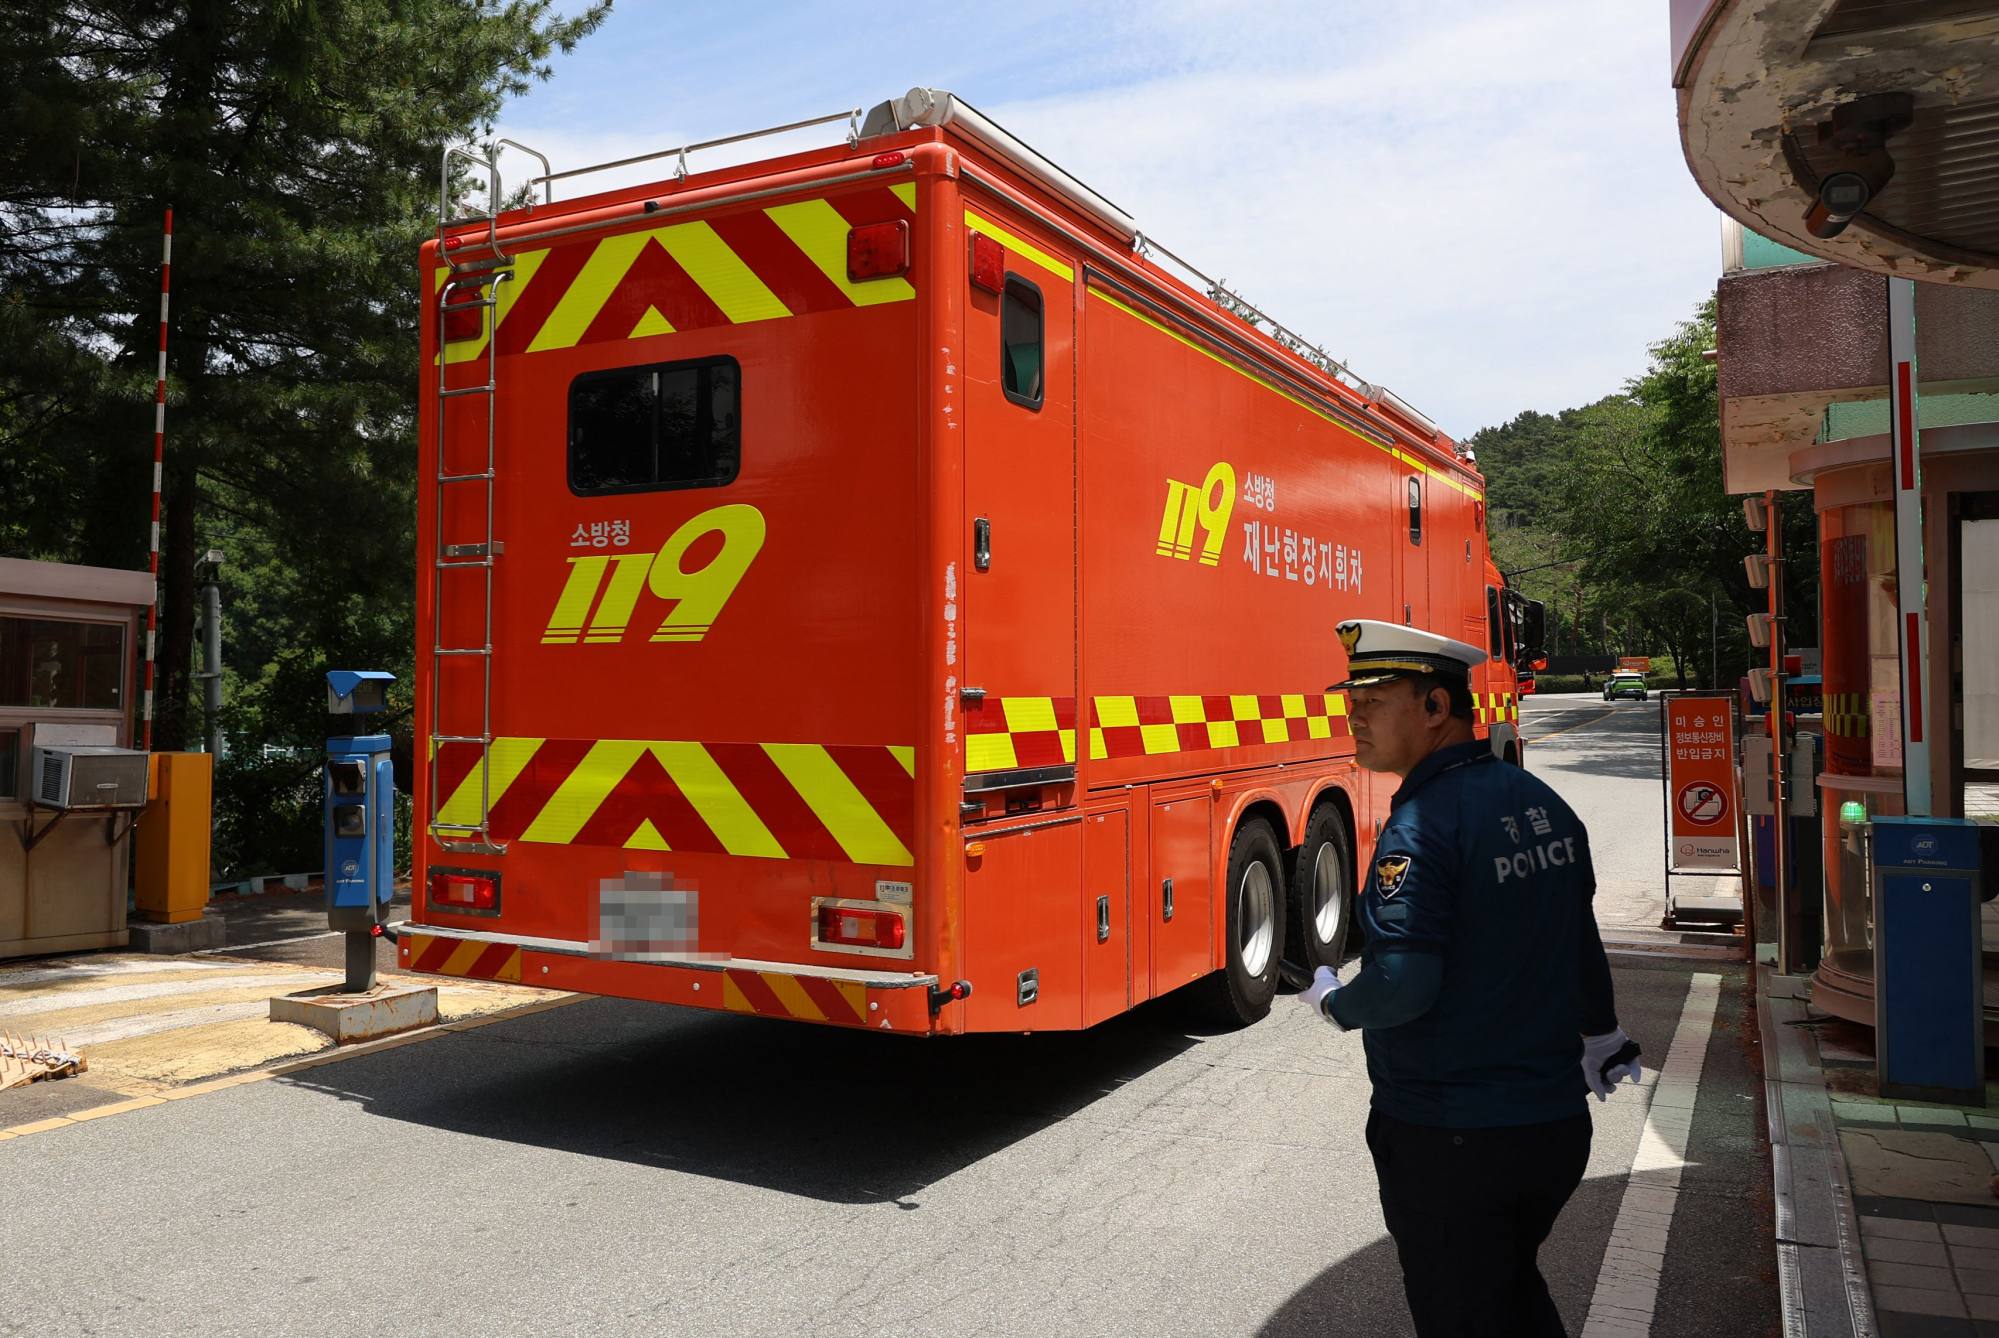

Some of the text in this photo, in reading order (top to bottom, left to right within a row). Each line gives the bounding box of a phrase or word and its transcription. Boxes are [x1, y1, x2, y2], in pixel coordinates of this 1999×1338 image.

[1243, 471, 1275, 512] 소방청
[569, 519, 630, 548] 소방청
[1155, 461, 1236, 567] 119
[540, 503, 767, 644] 119
[1243, 520, 1363, 595] 재난현장지휘차
[1675, 731, 1725, 744] 정보통신장비
[1676, 747, 1726, 760] 반입금지
